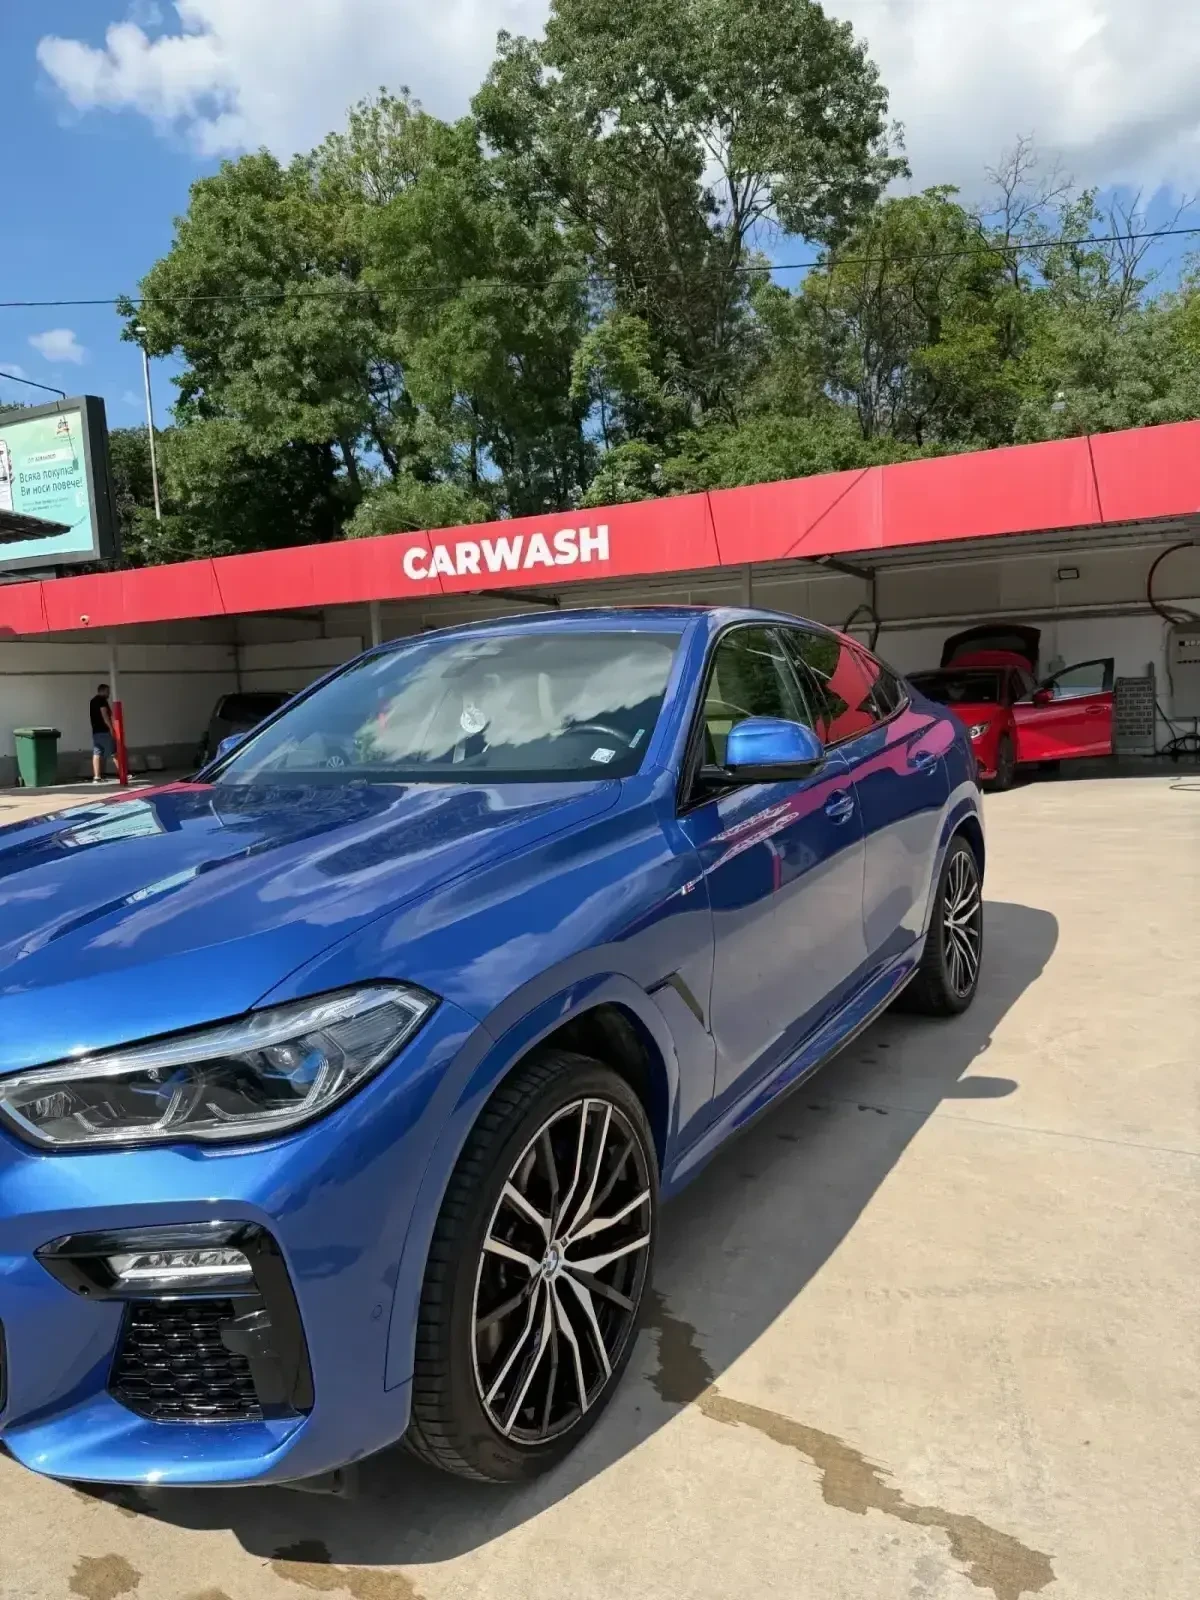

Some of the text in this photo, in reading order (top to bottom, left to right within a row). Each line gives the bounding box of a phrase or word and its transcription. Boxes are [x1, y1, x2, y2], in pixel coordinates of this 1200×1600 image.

[19, 466, 74, 484] Всяка покупка
[20, 477, 83, 497] Ви носи повече!
[402, 524, 610, 580] CARWASH
